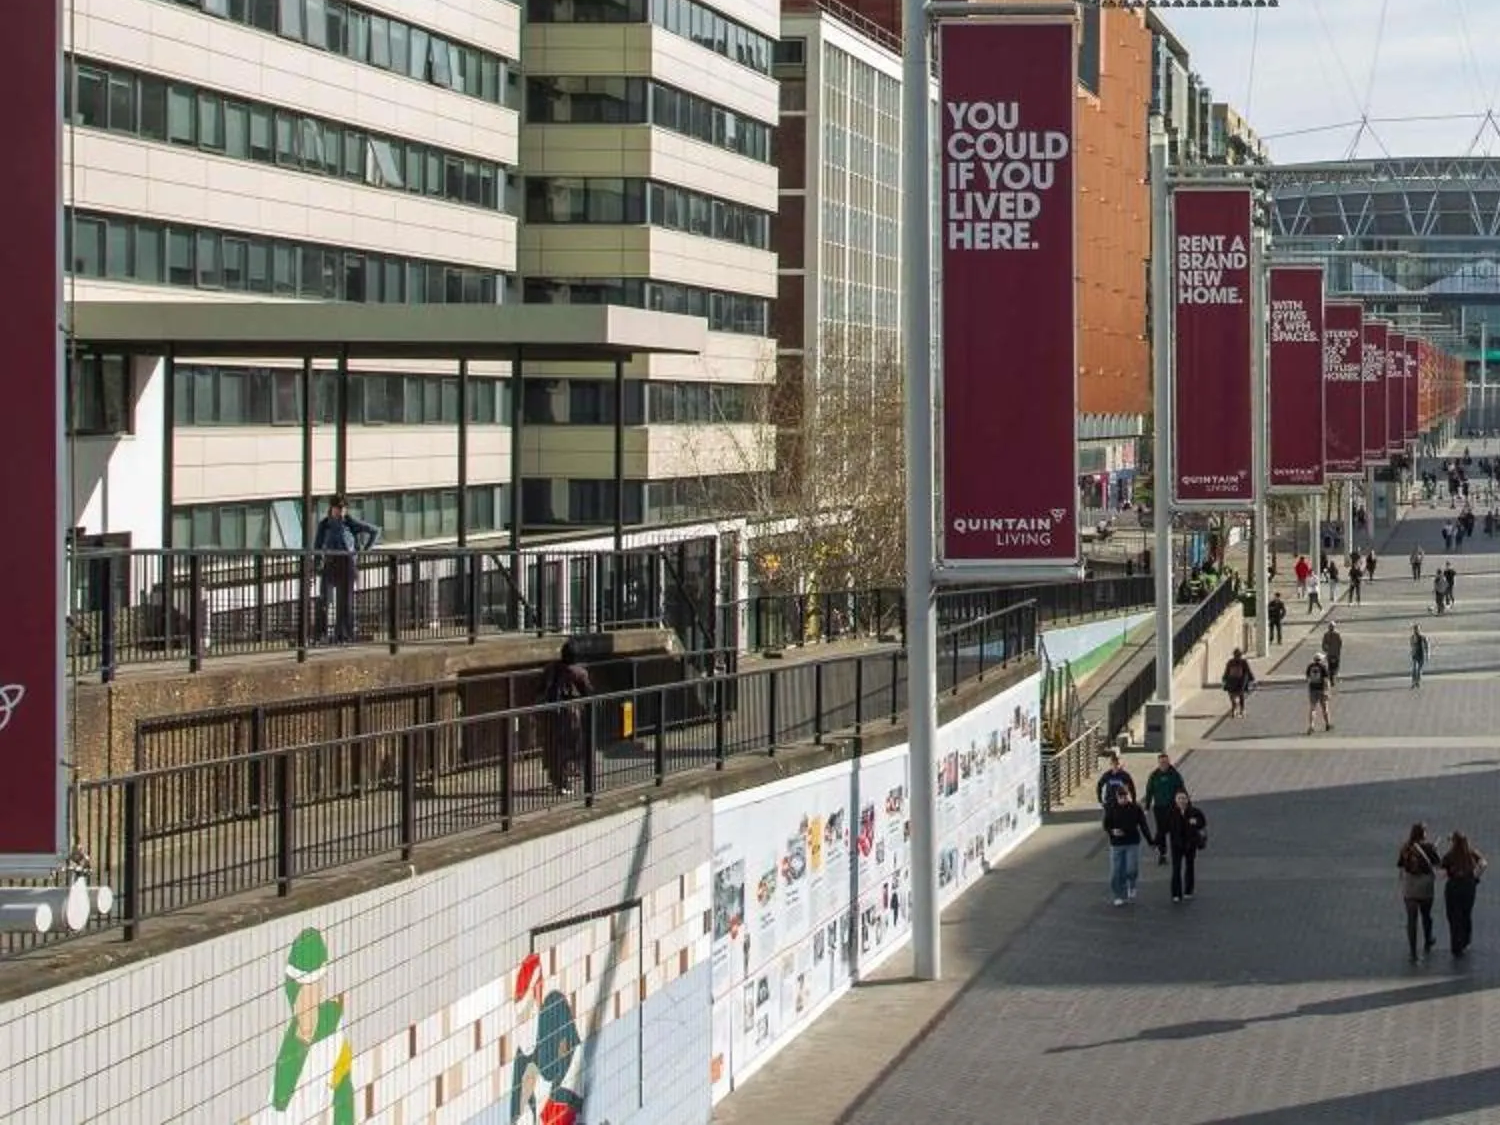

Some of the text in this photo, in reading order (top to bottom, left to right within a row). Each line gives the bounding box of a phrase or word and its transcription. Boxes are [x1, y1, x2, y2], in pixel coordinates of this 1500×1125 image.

[947, 102, 1018, 130] YOU
[948, 132, 1068, 160] COULD
[949, 162, 1054, 190] IF YOU
[949, 193, 1040, 219] LIVED
[949, 223, 1039, 249] HERE.
[1178, 236, 1245, 251] RENT A
[1179, 253, 1247, 269] BRAND
[1179, 270, 1221, 286] NEW
[1179, 287, 1243, 304] HOME.
[1272, 301, 1302, 310] WITH
[1272, 311, 1307, 320] GYMS
[1272, 331, 1319, 341] SPACES.
[1182, 476, 1239, 486] QUINTAIN
[953, 518, 1052, 534] QUINTAIN
[996, 533, 1051, 546] LIVING
